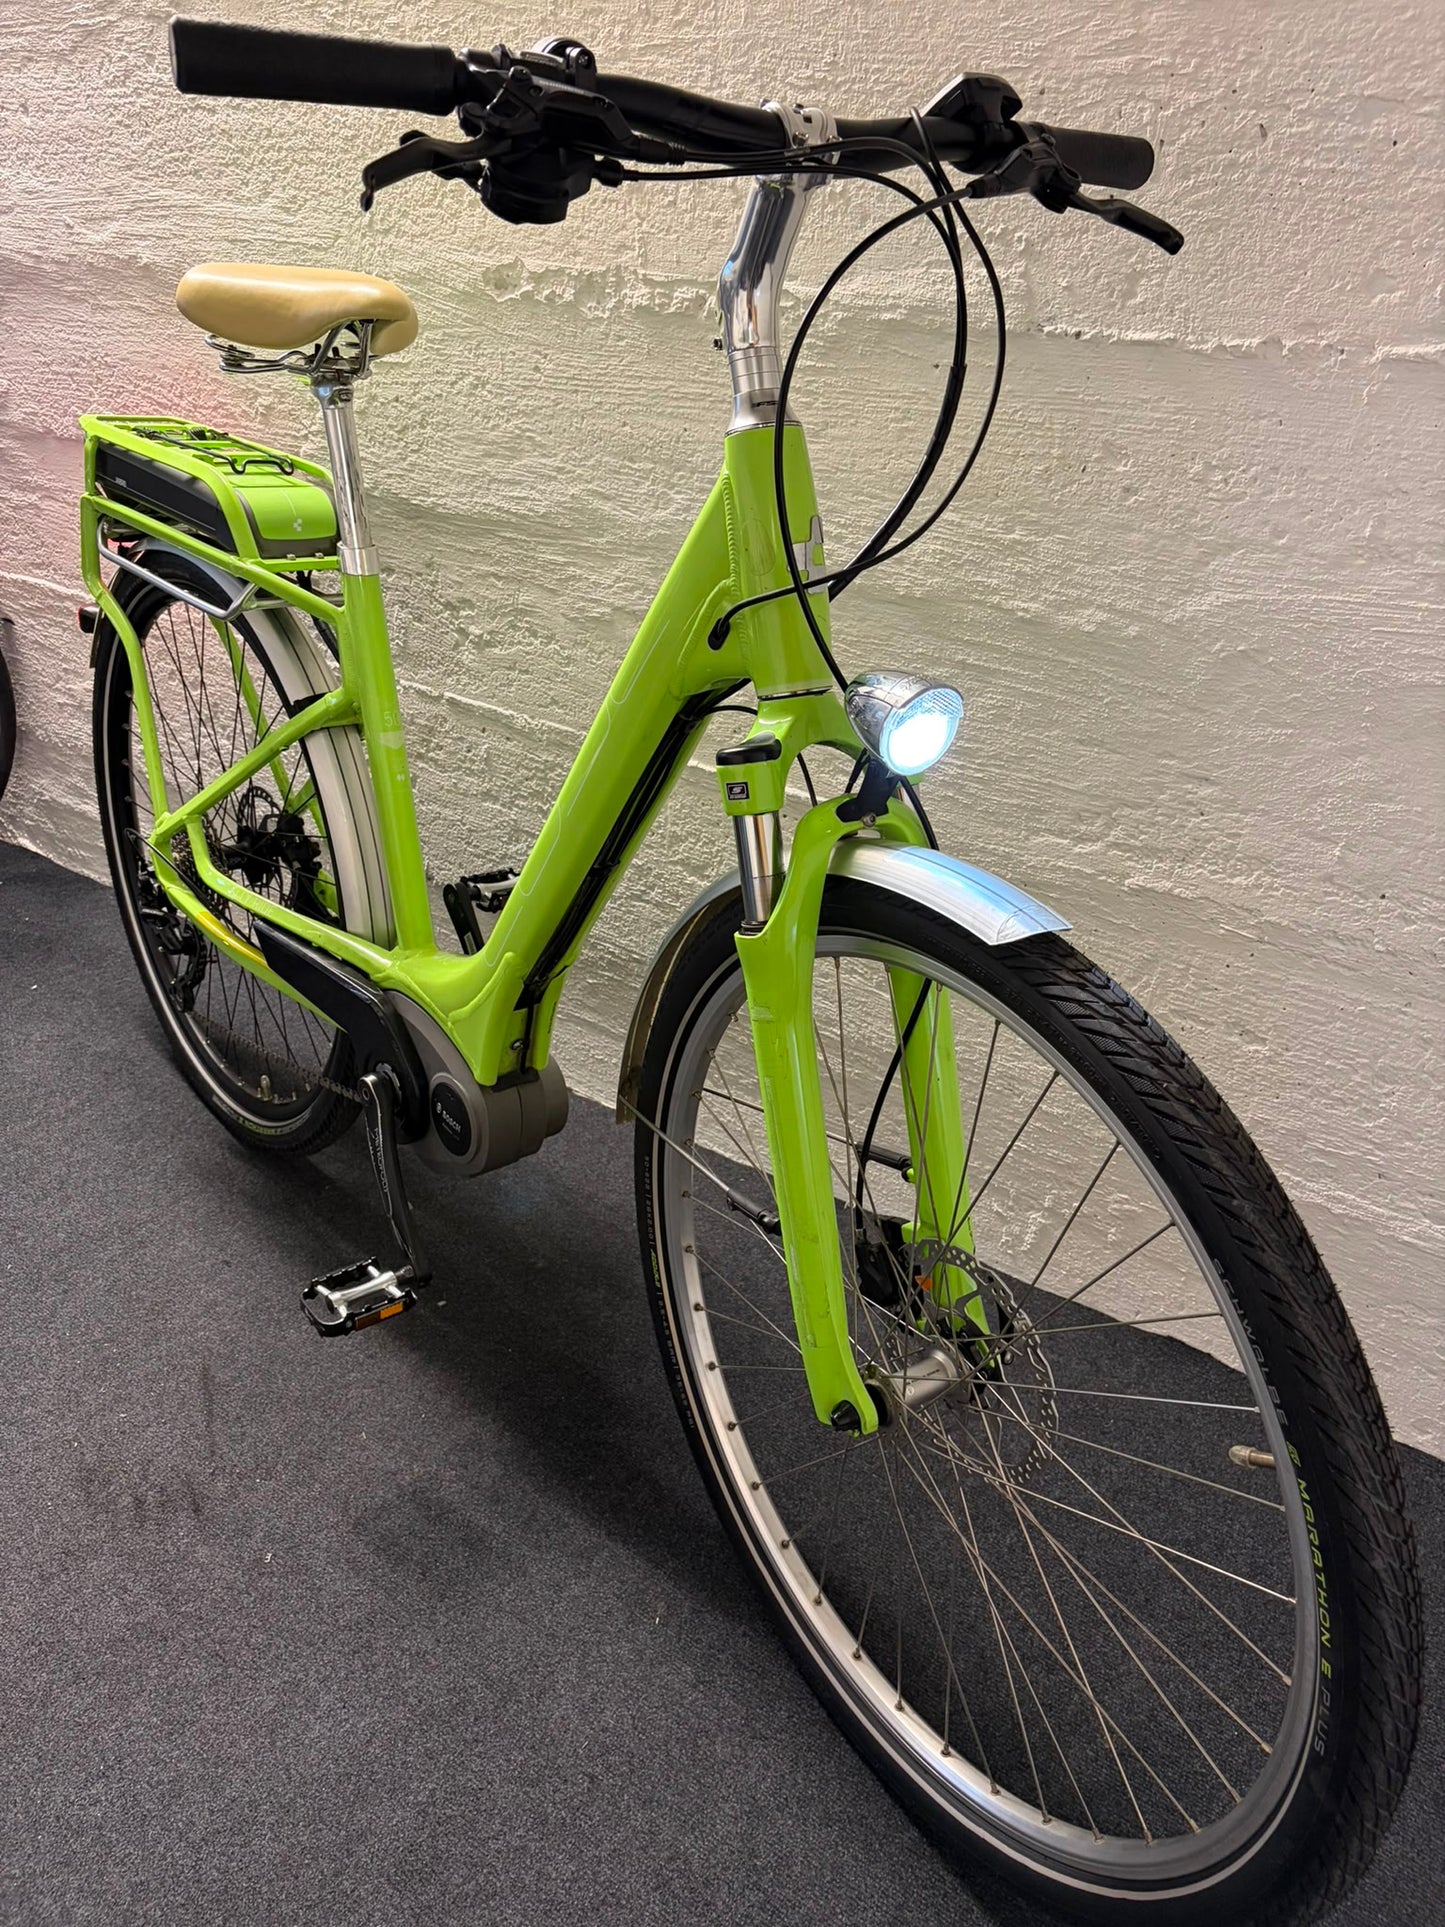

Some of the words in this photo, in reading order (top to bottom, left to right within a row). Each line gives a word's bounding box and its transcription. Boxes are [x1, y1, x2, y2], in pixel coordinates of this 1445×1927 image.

[1214, 1258, 1289, 1426] SCHWALBE
[1297, 1478, 1332, 1648] MARATHON
[1314, 1686, 1332, 1757] PLUS
[1321, 1657, 1332, 1679] E
